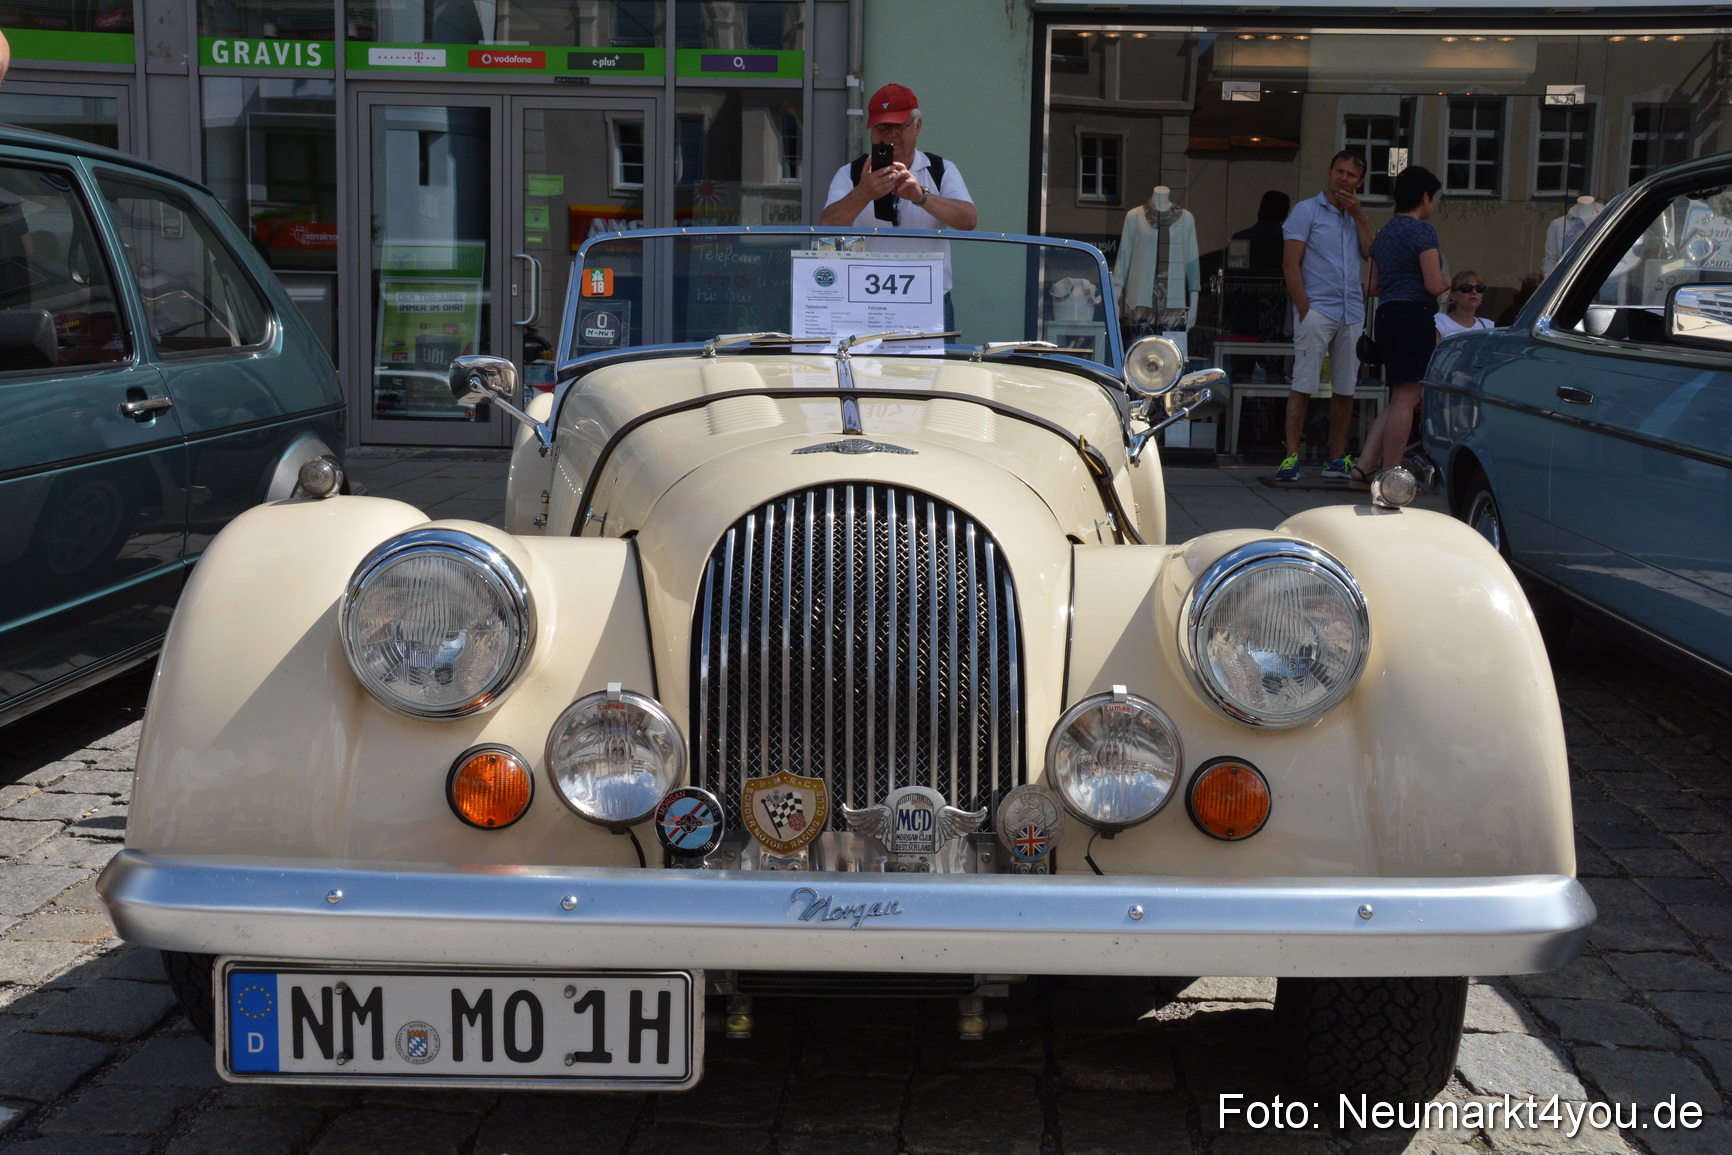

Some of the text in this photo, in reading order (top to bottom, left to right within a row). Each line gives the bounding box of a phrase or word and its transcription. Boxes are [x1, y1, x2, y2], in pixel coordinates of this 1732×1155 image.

[212, 40, 322, 66] GRAVIS
[494, 55, 533, 64] vodafone
[864, 274, 915, 294] 347
[423, 348, 448, 366] JBL
[659, 791, 686, 816] MORGAN
[696, 792, 720, 816] SPORTS
[744, 787, 825, 850] BORDER MOTOR RACING CLUB
[896, 808, 932, 832] MCD
[694, 841, 714, 855] CLUB
[895, 834, 932, 842] MORGAN-CLUB
[896, 844, 932, 852] DEUTSCHLAND
[791, 886, 904, 930] Morgan
[290, 985, 672, 1064] NM MO 1H
[248, 1032, 264, 1054] D
